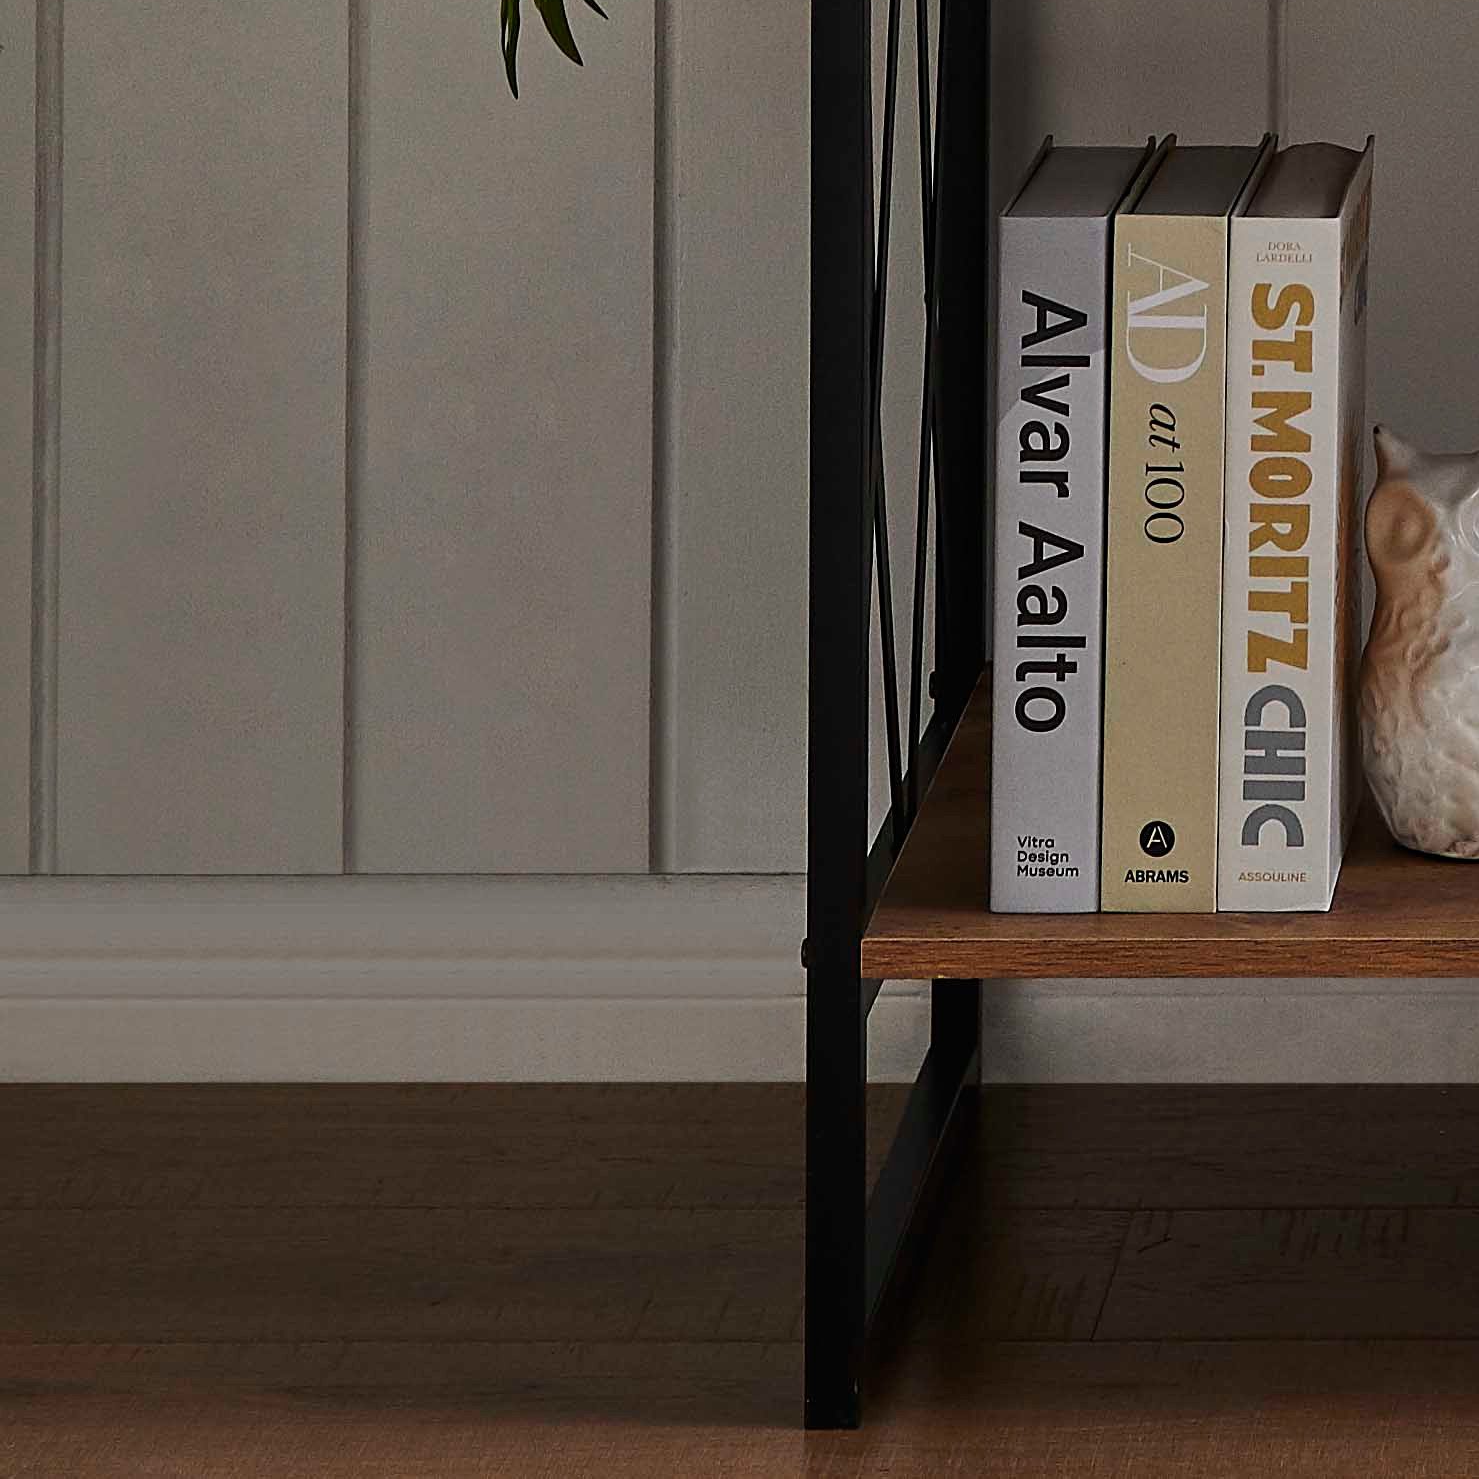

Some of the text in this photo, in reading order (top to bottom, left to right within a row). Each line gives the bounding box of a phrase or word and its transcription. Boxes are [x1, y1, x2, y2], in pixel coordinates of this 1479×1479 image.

[1267, 241, 1302, 251] DORA
[1256, 252, 1313, 263] LARDELLI
[1126, 242, 1210, 544] AD at 100
[1014, 289, 1091, 733] Alvar Aalto
[1241, 282, 1315, 848] ST. MORITZ CHIC
[1016, 835, 1055, 848] Vitra
[1016, 850, 1070, 864] Design
[1016, 864, 1079, 877] Museum
[1124, 869, 1190, 883] ABRAMS
[1238, 871, 1307, 882] ASSOULINE
